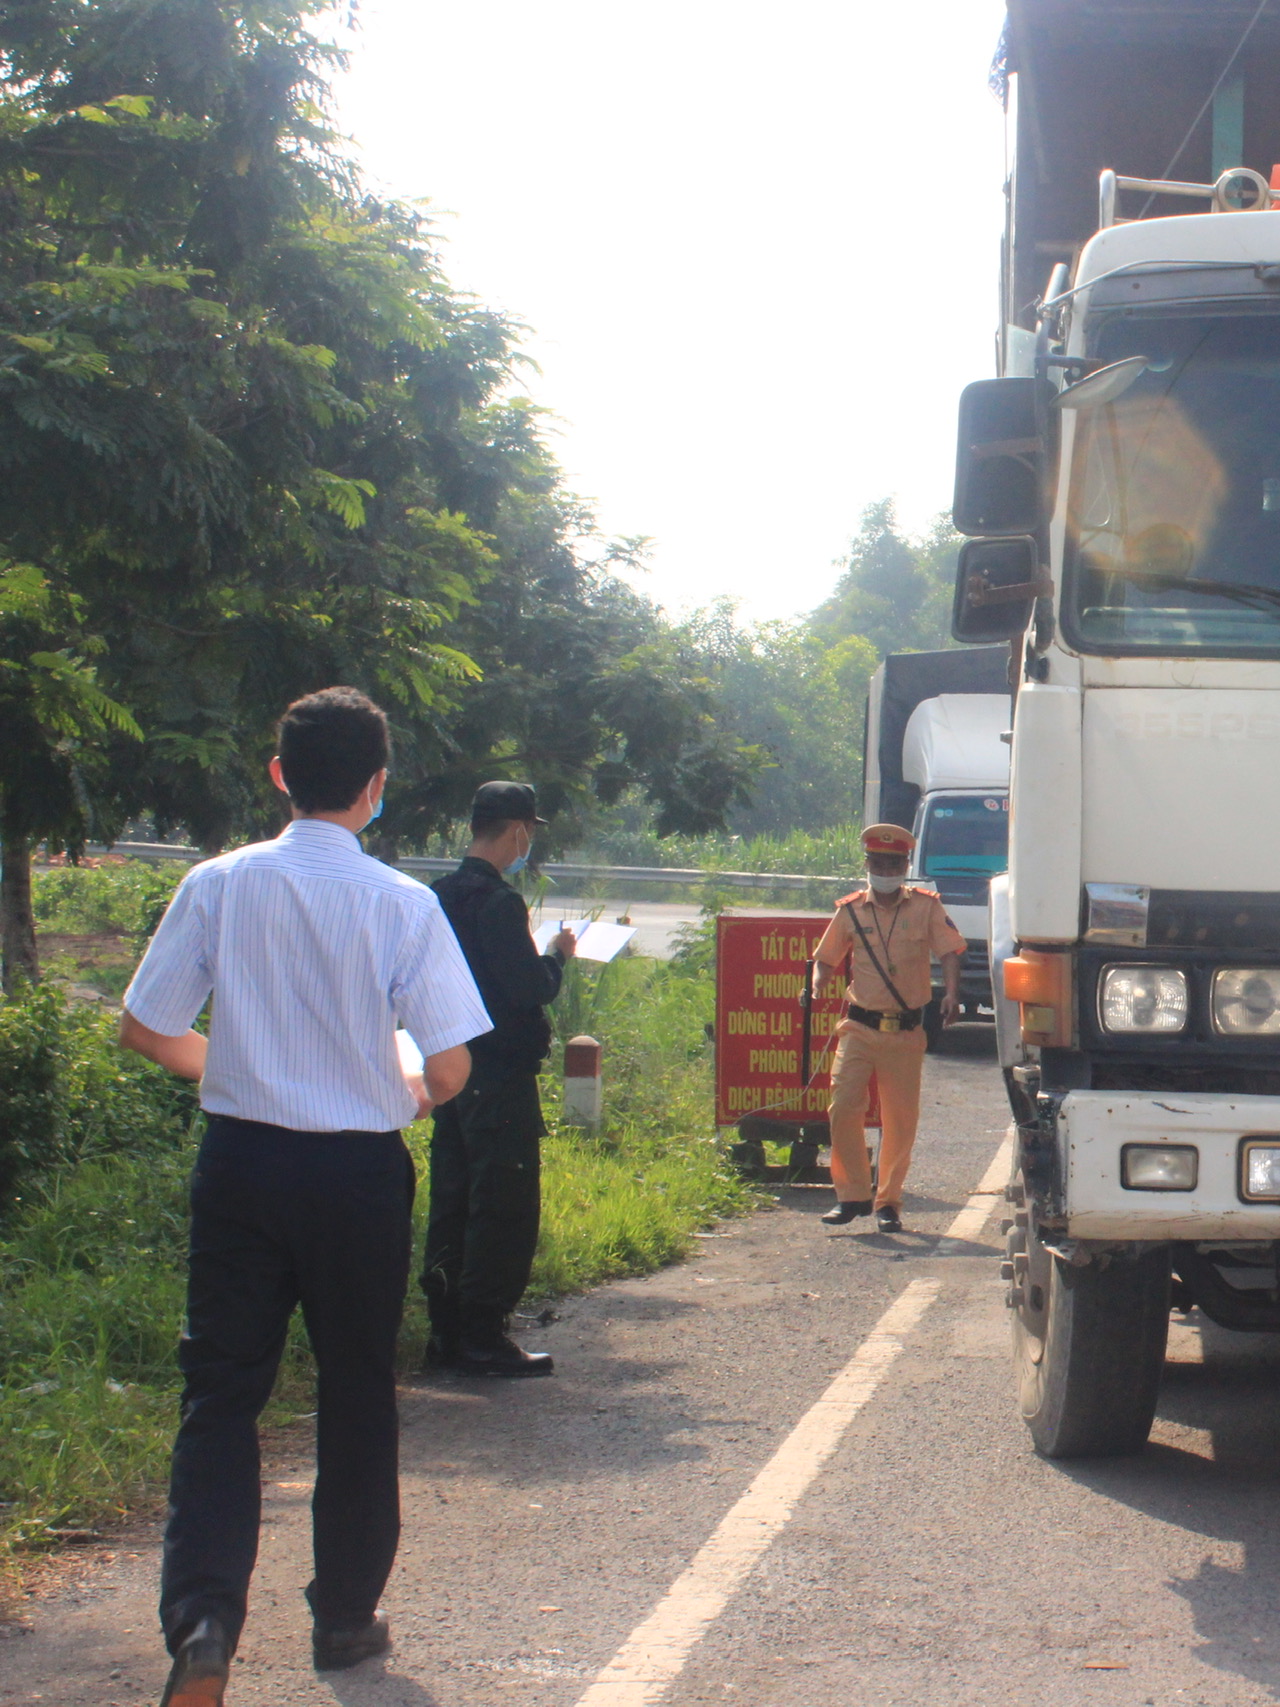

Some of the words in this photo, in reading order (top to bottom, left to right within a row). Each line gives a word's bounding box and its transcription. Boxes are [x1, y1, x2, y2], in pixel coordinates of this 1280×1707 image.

[761, 928, 785, 961] TẤT
[789, 929, 808, 961] CẢ
[728, 1006, 766, 1035] DỪNG
[771, 1011, 792, 1042] LẠI
[749, 1043, 797, 1073] PHÒNG
[728, 1086, 761, 1116] DỊCH
[765, 1082, 803, 1116] BỆNH
